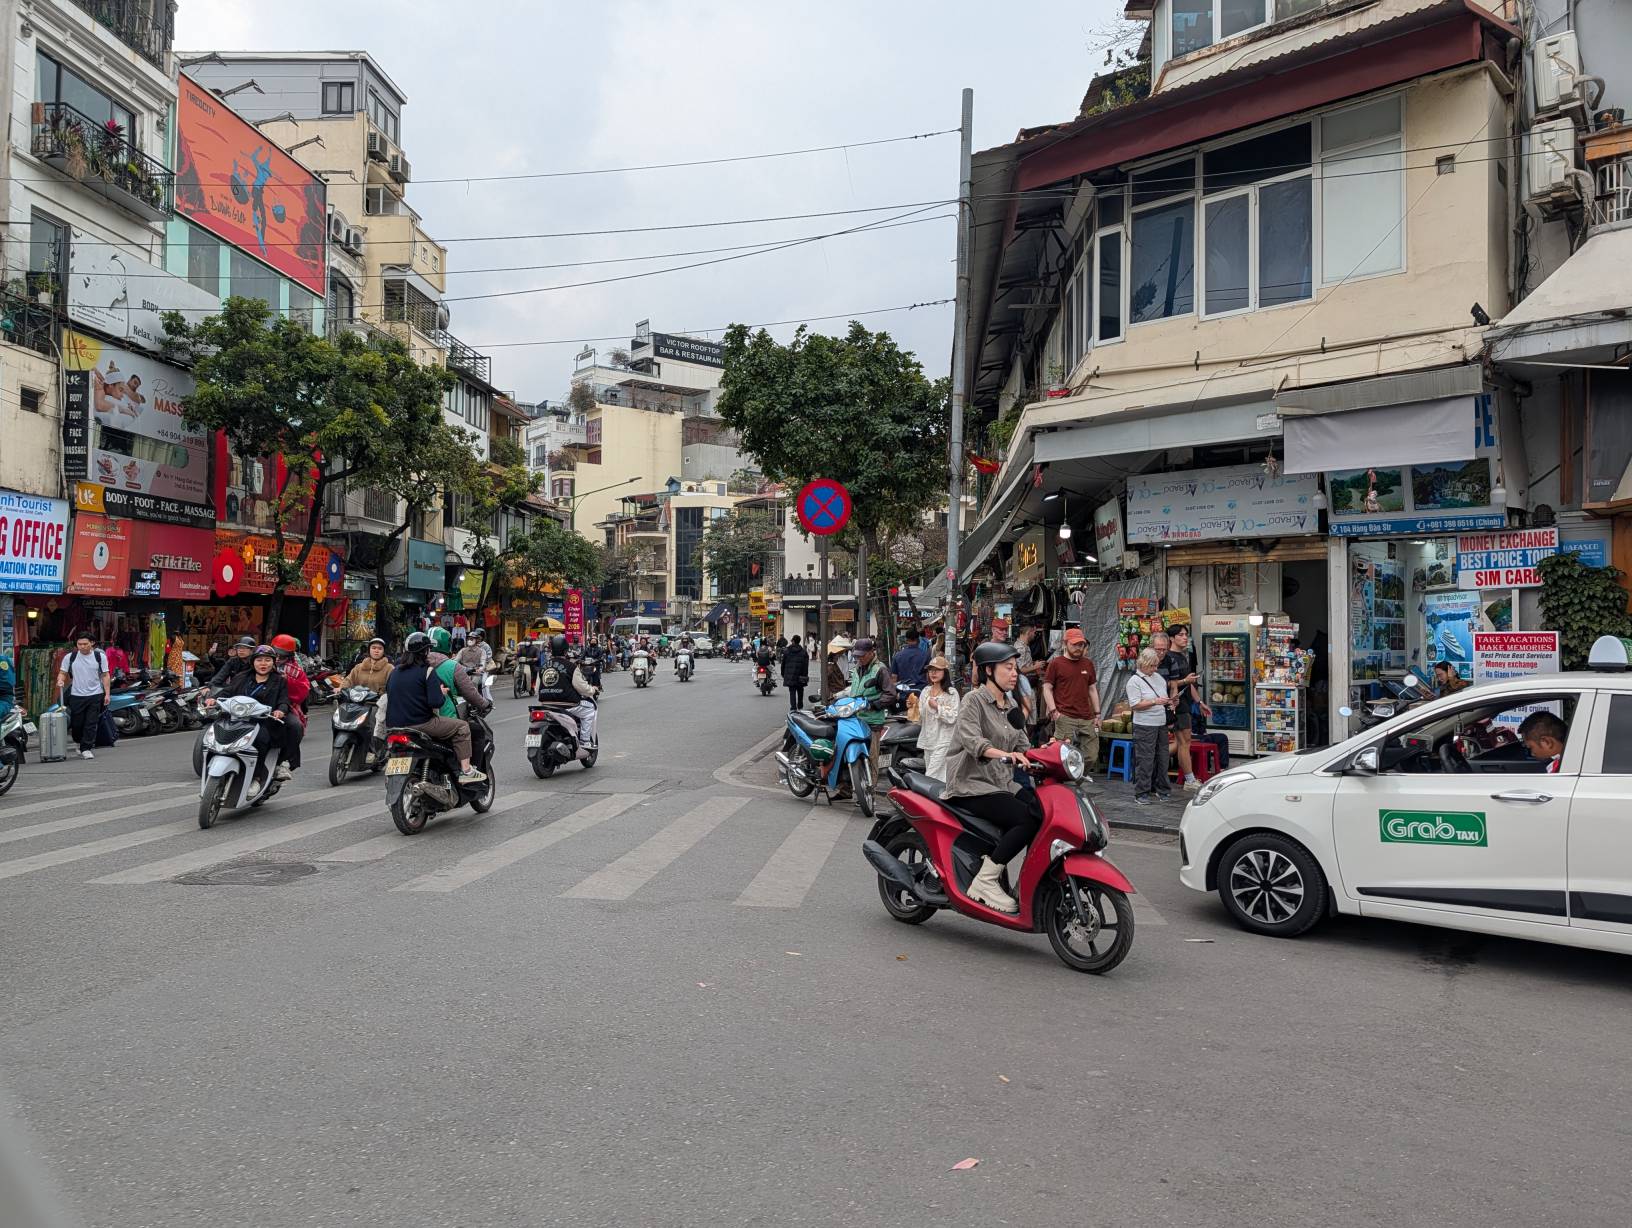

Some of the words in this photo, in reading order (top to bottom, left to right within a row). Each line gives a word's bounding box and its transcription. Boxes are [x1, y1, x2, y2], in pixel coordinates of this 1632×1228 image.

[142, 299, 159, 314] BODY
[666, 338, 690, 349] VICTOR
[690, 344, 720, 354] ROOFTOP
[682, 350, 724, 364] RESTAURANT
[70, 393, 82, 402] BODY
[69, 411, 82, 420] FOOT
[154, 397, 184, 418] MASS
[70, 428, 82, 437] FACE
[64, 446, 86, 454] MASSAGE
[0, 494, 52, 512] nhTourist
[106, 492, 128, 505] BODY
[134, 496, 154, 510] FOOT
[160, 502, 179, 513] FACE
[184, 506, 215, 519] MASSAGE
[12, 518, 64, 560] OFFICE
[1460, 534, 1496, 552] MONEY
[1500, 530, 1556, 548] EXCHANGE
[1460, 552, 1487, 570] BEST
[1491, 551, 1523, 568] PRICE
[0, 561, 26, 575] MATION
[28, 564, 58, 577] CENTER
[1475, 570, 1500, 586] SIM
[1485, 660, 1506, 670] Money
[1507, 661, 1538, 669] exchange
[1387, 816, 1455, 839] Grab
[1456, 830, 1479, 840] TAXI
